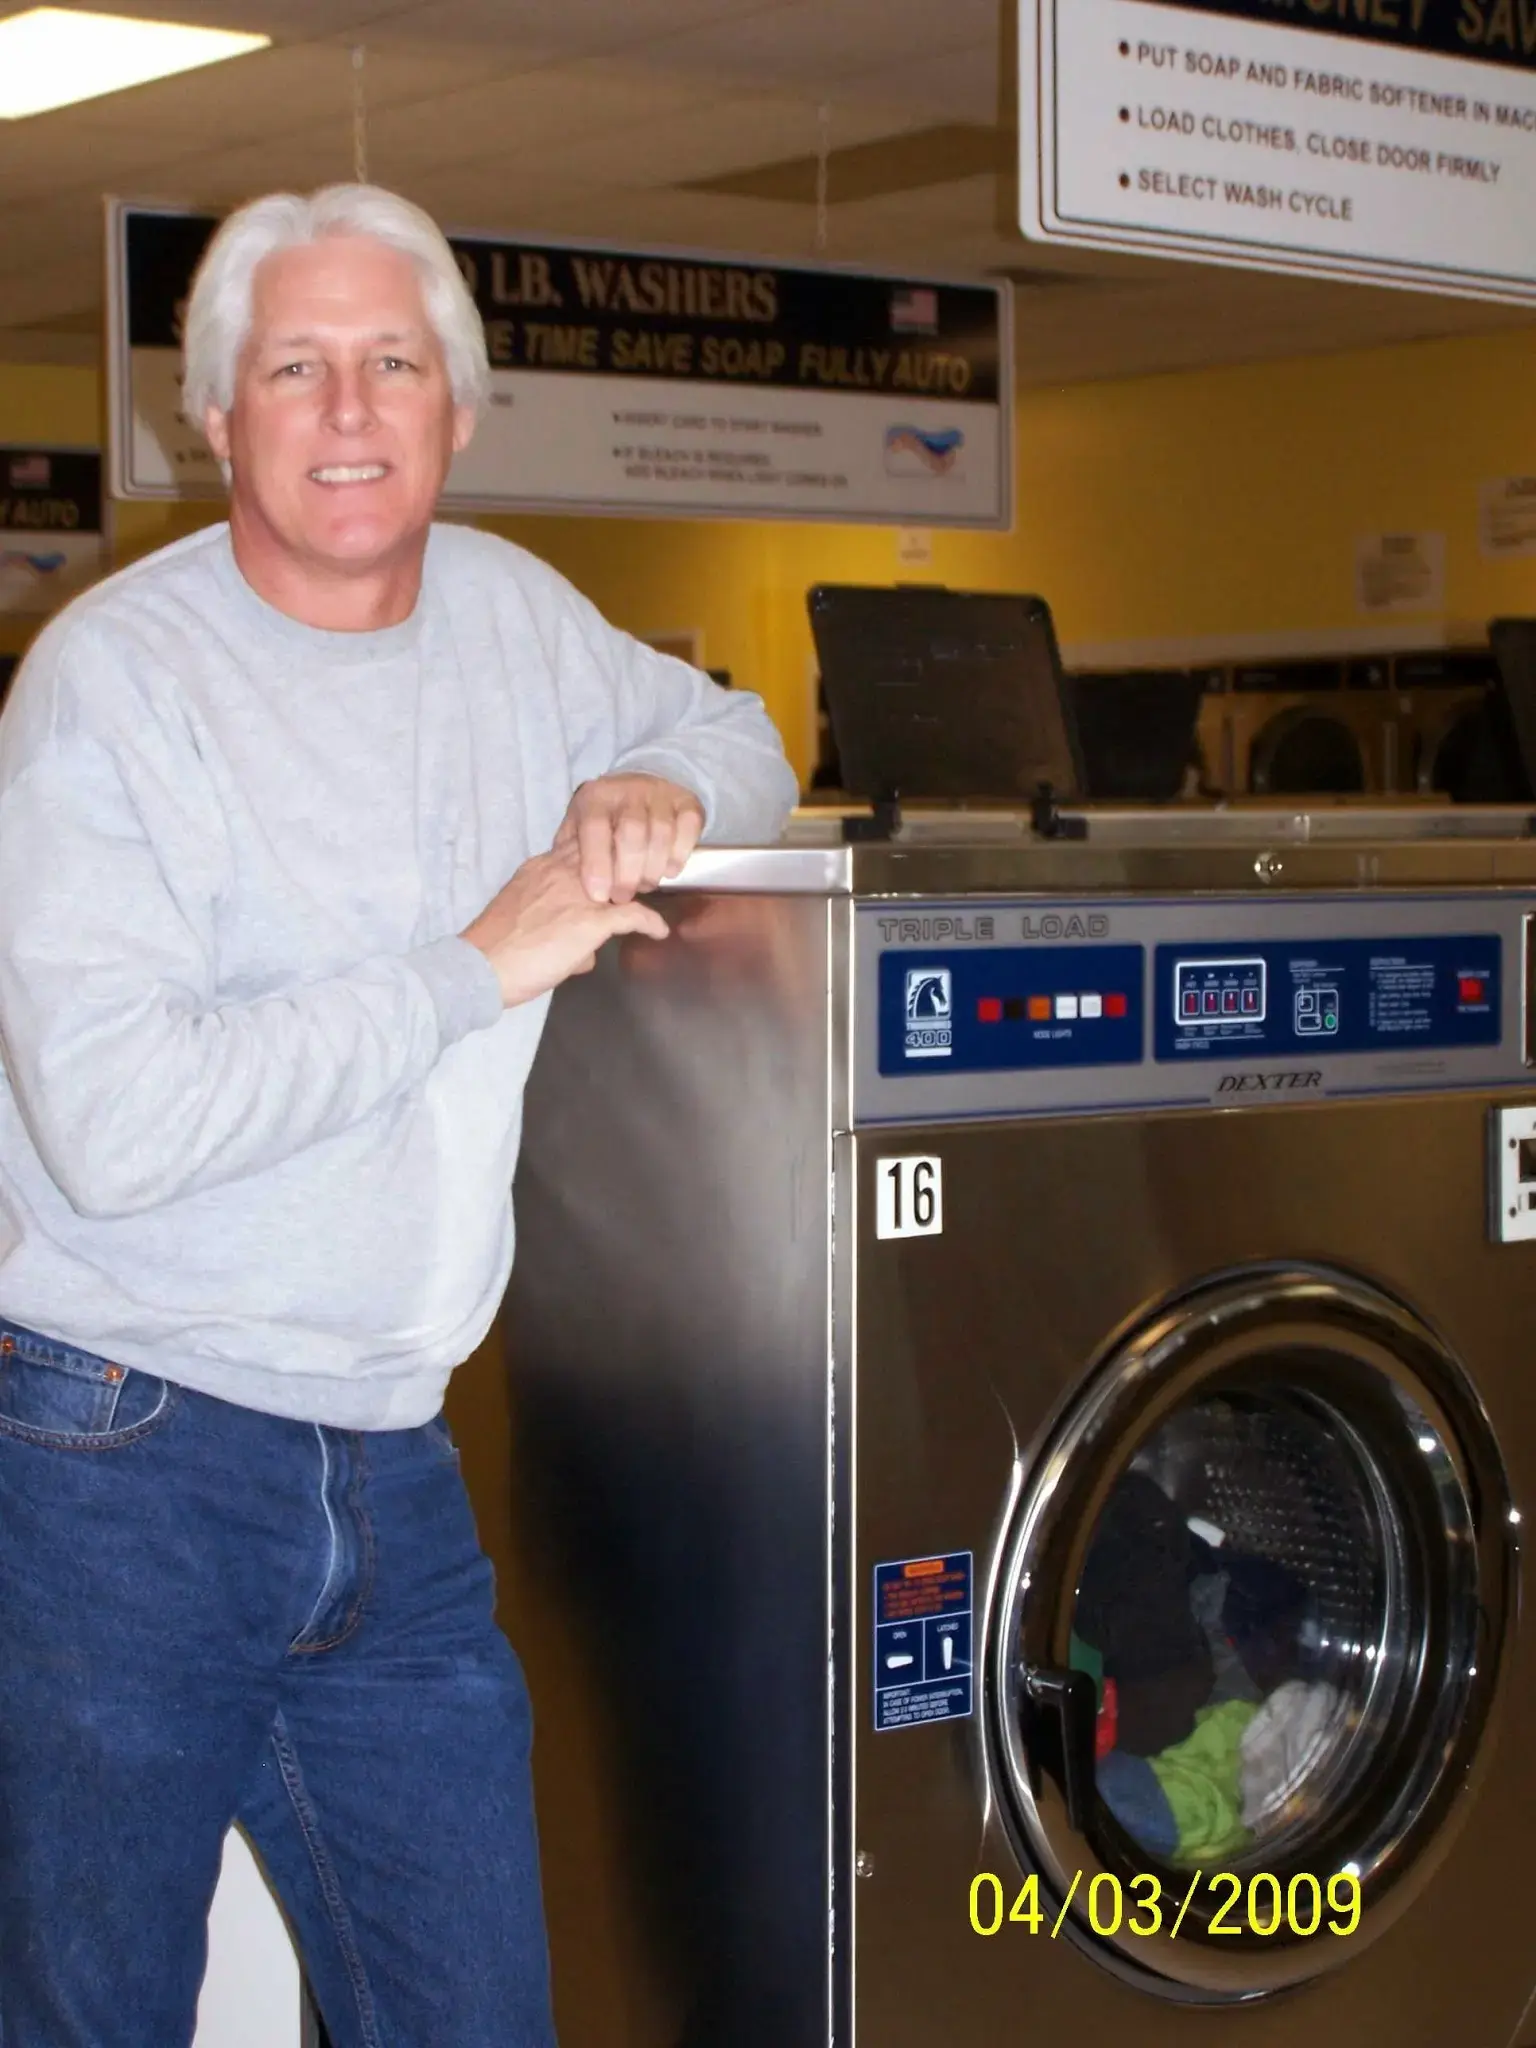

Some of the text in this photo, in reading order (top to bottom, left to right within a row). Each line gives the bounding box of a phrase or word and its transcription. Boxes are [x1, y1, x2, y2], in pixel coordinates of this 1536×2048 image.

[1137, 41, 1536, 132] PUT SOAP AND FABRIC SOFTENER IN MAC
[1137, 104, 1195, 135] LOAD
[1306, 132, 1371, 164] CLOSE
[1377, 143, 1431, 173] DOOR
[1437, 152, 1500, 184] FIRMLY
[1138, 168, 1353, 221] SELECT WASH CYCLE
[571, 258, 778, 322] WASHERS
[524, 322, 599, 366] TIME
[612, 328, 693, 371] SAVE
[700, 336, 785, 377] SOAP
[800, 343, 890, 386] FULLY
[893, 350, 972, 394] AUTO
[878, 914, 1110, 942] TRIPLE LOAD
[906, 1029, 952, 1048] 400
[1217, 1071, 1323, 1093] DEXTER
[887, 1161, 935, 1230] 16
